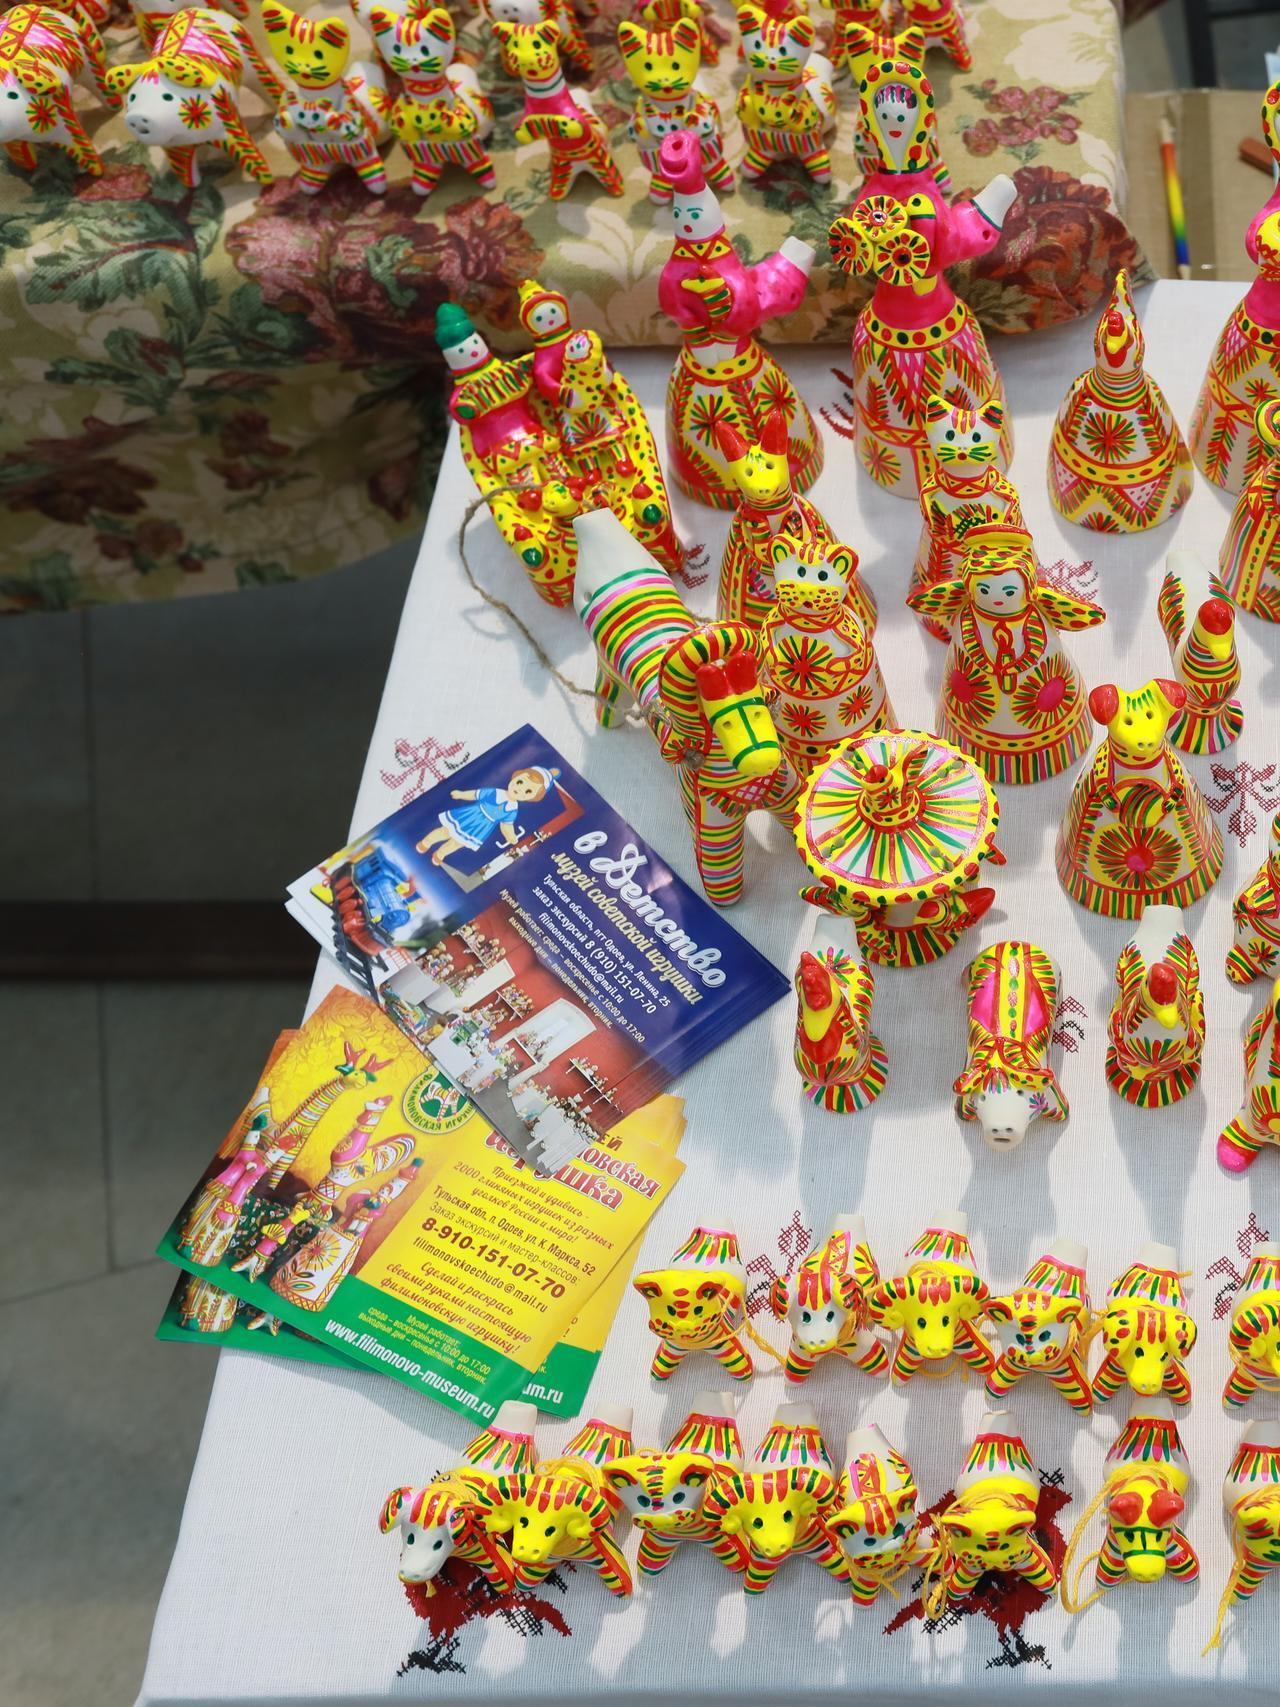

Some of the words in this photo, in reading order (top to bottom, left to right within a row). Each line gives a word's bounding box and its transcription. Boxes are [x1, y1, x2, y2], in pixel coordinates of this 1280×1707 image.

[573, 830, 608, 855] в
[532, 886, 554, 908] заказ
[550, 905, 589, 943] экскурсий
[550, 852, 600, 892] музей
[586, 888, 657, 953] советской
[644, 948, 704, 1005] игрушки
[589, 839, 727, 988] Детство
[499, 888, 520, 910] Музей
[514, 906, 545, 938] работает:
[542, 935, 561, 955] среда
[563, 958, 600, 997] воскресенье
[601, 998, 621, 1017] 10:00
[616, 1015, 628, 1026] до
[625, 1023, 646, 1043] 17:00
[508, 916, 538, 948] выходные
[533, 945, 549, 960] дни
[550, 962, 592, 1004] понедельник,
[587, 1001, 613, 1030] вторник.
[538, 912, 625, 1004] filimonovskoechudo@mail.ru
[543, 873, 571, 904] Тульская
[568, 903, 593, 930] область,
[593, 928, 607, 941] пгт
[604, 938, 626, 964] Одоев,
[621, 960, 635, 974] ул.
[633, 970, 660, 999] Ленина,
[658, 995, 671, 1007] 25
[584, 940, 596, 950] 8
[589, 947, 618, 974] (910)
[613, 970, 657, 1014] 151-07-70
[433, 1184, 472, 1211] Тульская
[488, 1215, 497, 1225] п.
[497, 1217, 525, 1240] Одоев,
[523, 1233, 538, 1246] ул.
[537, 1238, 548, 1250] К.
[547, 1243, 581, 1270] Маркса,
[581, 1262, 596, 1277] 52
[453, 1160, 480, 1179] 2000
[479, 1173, 522, 1201] глиняных
[523, 1199, 564, 1222] игрушек
[563, 1218, 577, 1231] из
[572, 1224, 615, 1250] разных
[470, 1187, 511, 1209] уголков
[508, 1203, 541, 1225] России
[539, 1220, 548, 1229] и
[545, 1225, 579, 1244] мира!
[491, 1166, 540, 1196] Приезжай
[538, 1191, 547, 1199] и
[544, 1194, 583, 1218] удивись
[412, 1236, 549, 1313] filimonovskoechudo@mail.ru
[421, 1217, 566, 1299] 8-910-151-07-70
[429, 1201, 456, 1221] Заказ
[454, 1215, 501, 1243] экскурсий
[499, 1238, 508, 1247] и
[506, 1241, 581, 1287] мастер-классов:
[380, 1277, 467, 1325] филимоновскую
[465, 1321, 521, 1355] игрушку!
[386, 1263, 426, 1287] своими
[421, 1282, 467, 1308] руками
[464, 1303, 532, 1343] настоящую
[420, 1261, 459, 1287] Сделай
[457, 1282, 466, 1291] и
[462, 1285, 514, 1316] раскрась
[324, 1319, 496, 1419] www.filimonovo-museum.ru
[358, 1312, 393, 1334] выходные
[391, 1330, 406, 1340] дни
[410, 1339, 456, 1368] понедельник,
[457, 1364, 486, 1384] вторник.
[367, 1307, 389, 1322] среда
[392, 1319, 435, 1345] воскресенье
[440, 1342, 461, 1358] 10:00
[457, 1354, 470, 1364] до
[470, 1359, 491, 1375] 17:00
[406, 1314, 430, 1332] Музей
[429, 1327, 461, 1348] работает:
